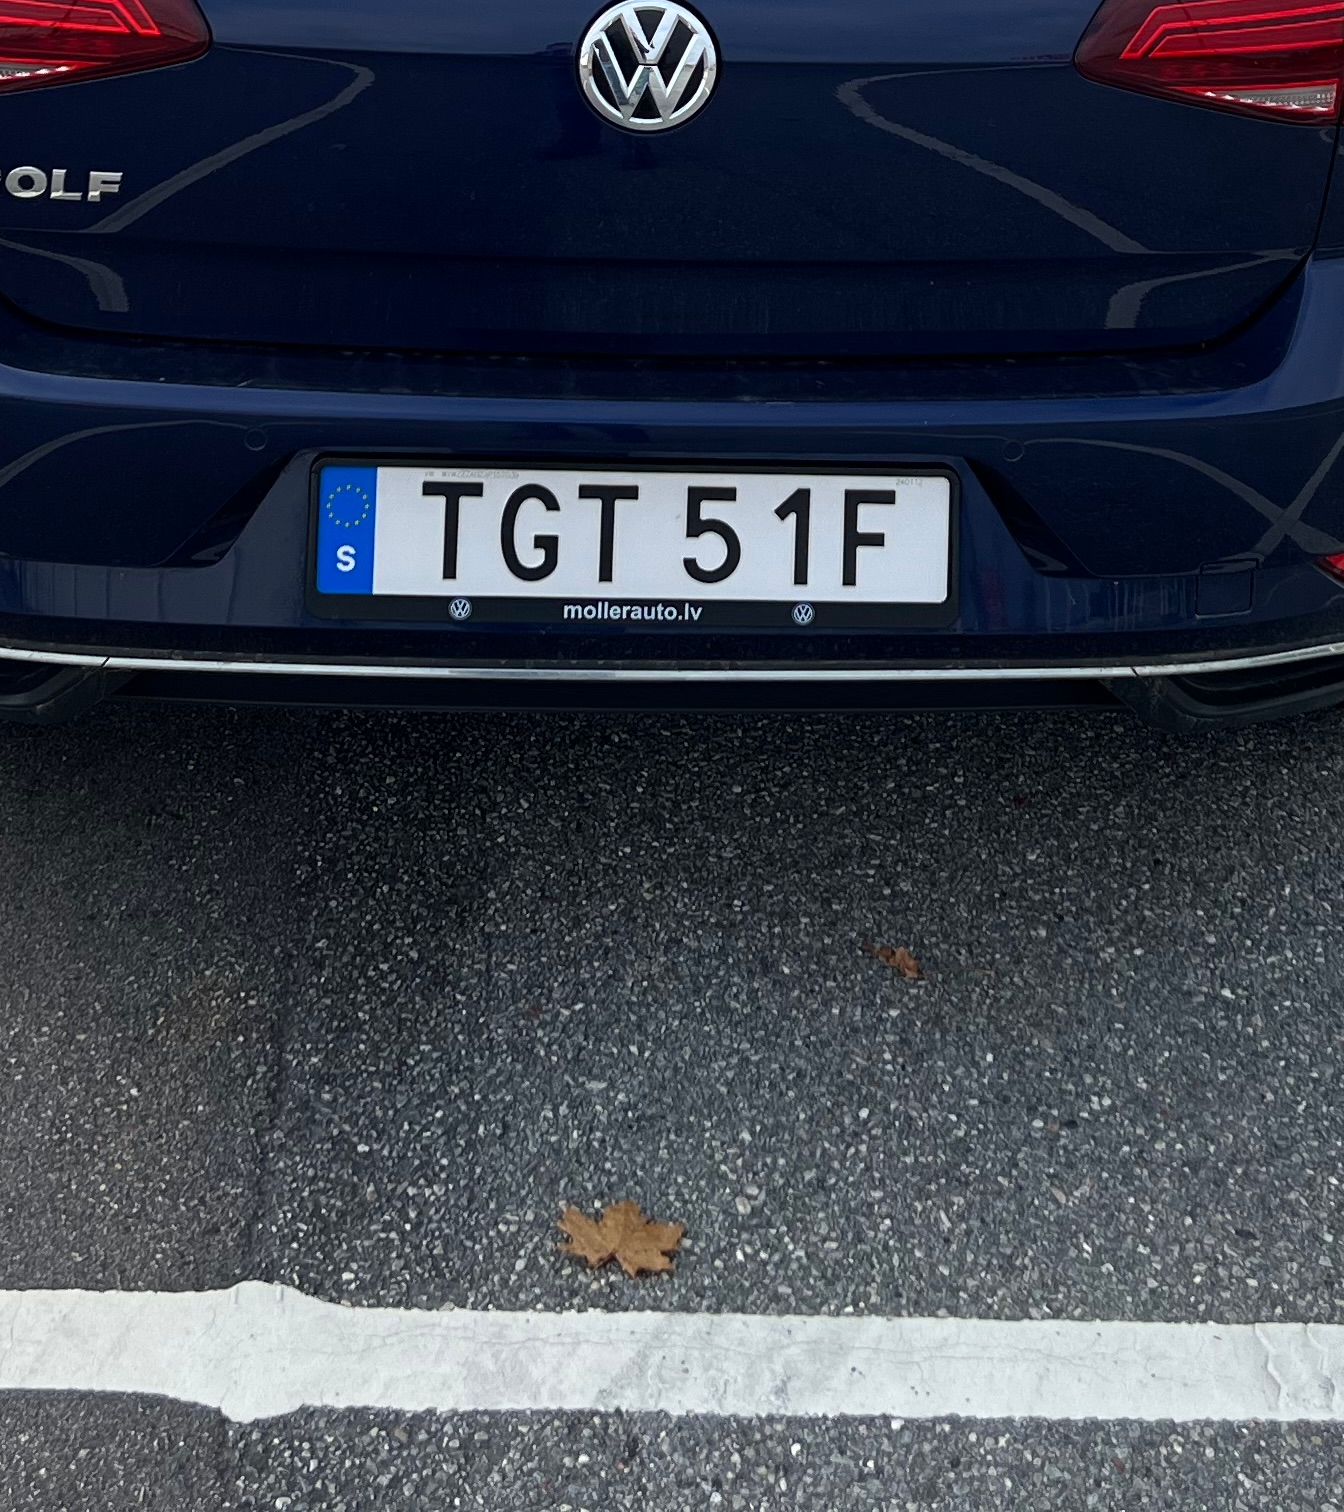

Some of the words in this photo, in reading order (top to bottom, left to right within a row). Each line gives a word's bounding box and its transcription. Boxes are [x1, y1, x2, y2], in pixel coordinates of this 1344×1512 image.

[421, 481, 639, 584] TGT
[682, 486, 897, 587] 51F
[336, 545, 357, 573] S
[563, 601, 703, 622] mollerauto.lv
